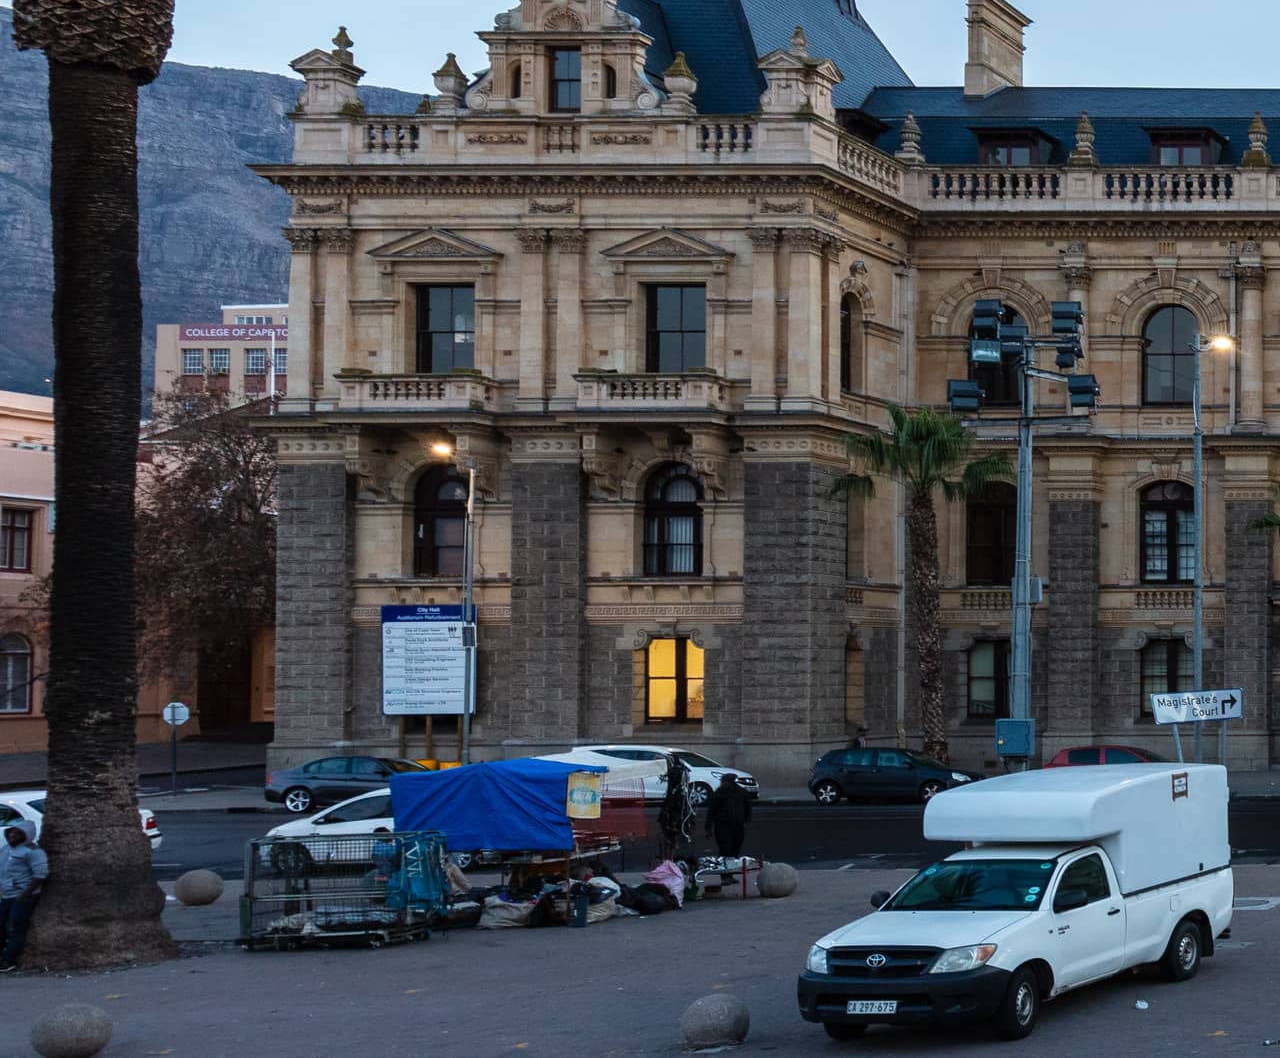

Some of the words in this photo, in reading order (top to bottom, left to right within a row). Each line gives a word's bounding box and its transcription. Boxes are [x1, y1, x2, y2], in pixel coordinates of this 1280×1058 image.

[185, 328, 229, 337] COLLEGE
[232, 328, 246, 337] OF
[248, 328, 274, 337] CAPE
[1157, 694, 1218, 708] Magistrate's
[1192, 708, 1218, 717] Court
